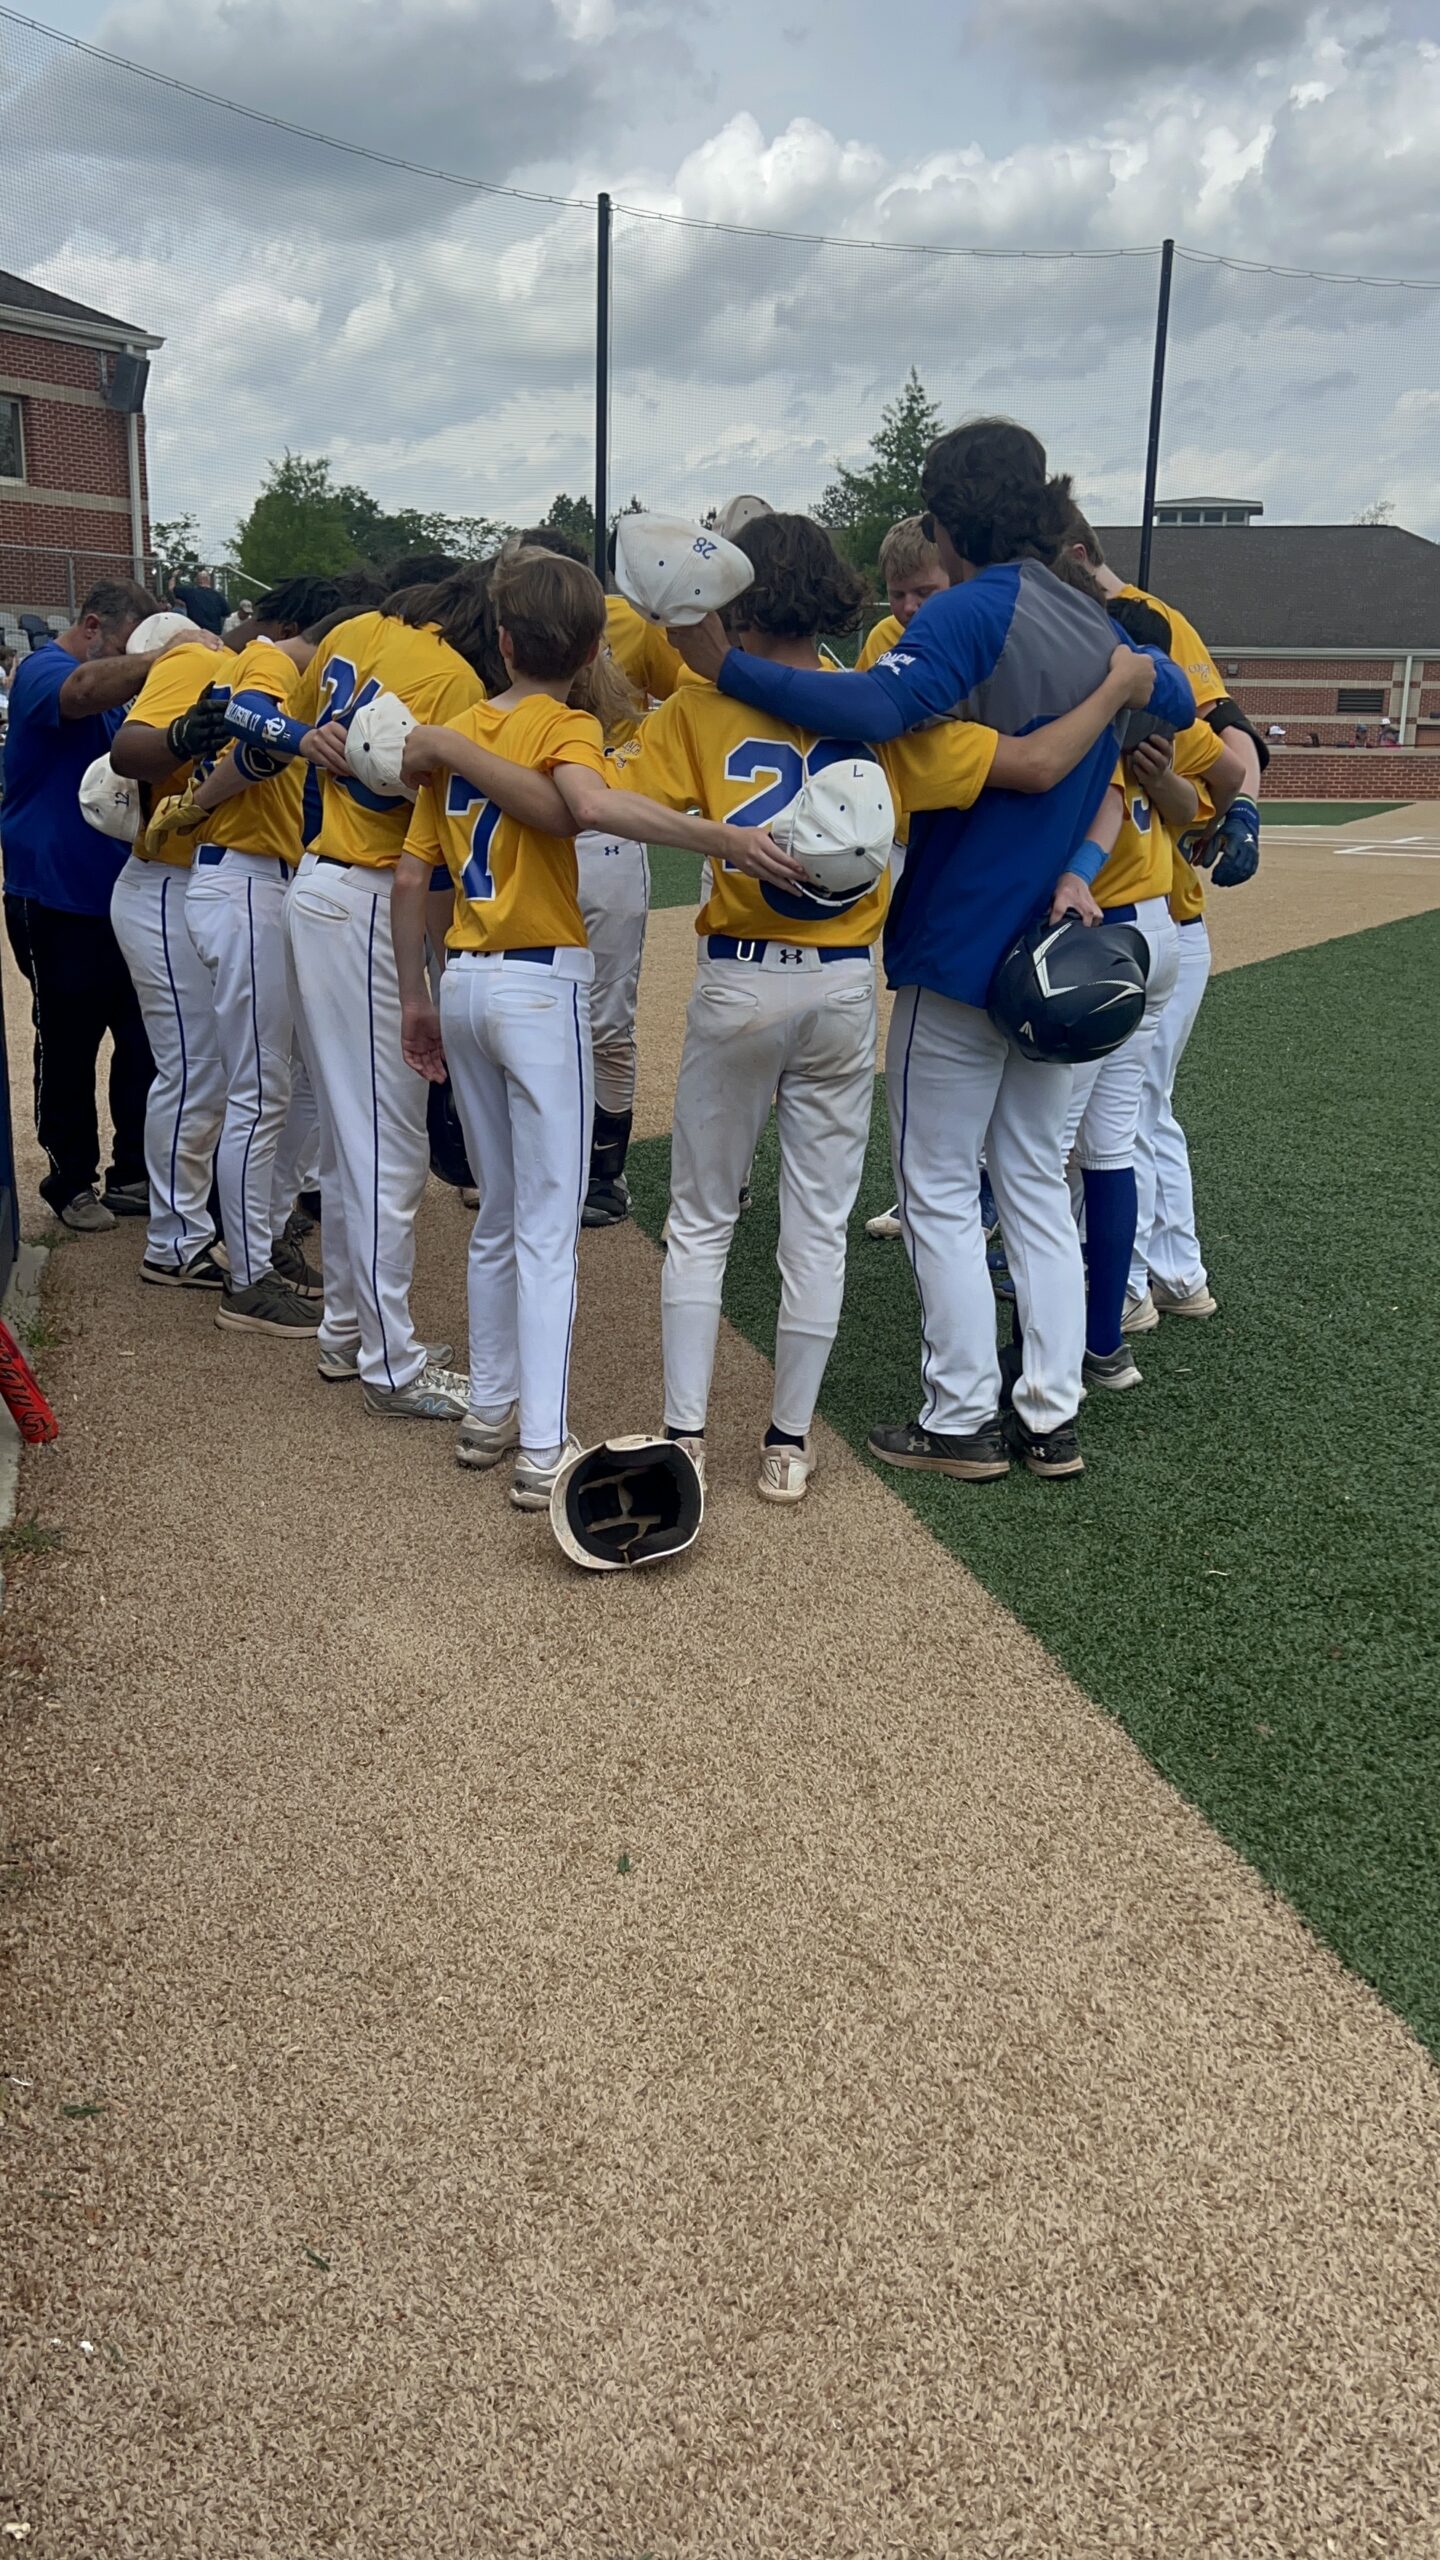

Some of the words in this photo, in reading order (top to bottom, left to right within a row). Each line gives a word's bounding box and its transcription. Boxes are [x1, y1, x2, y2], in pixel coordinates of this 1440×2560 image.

[692, 537, 717, 560] 28
[115, 792, 129, 806] 12
[445, 773, 503, 901] 7
